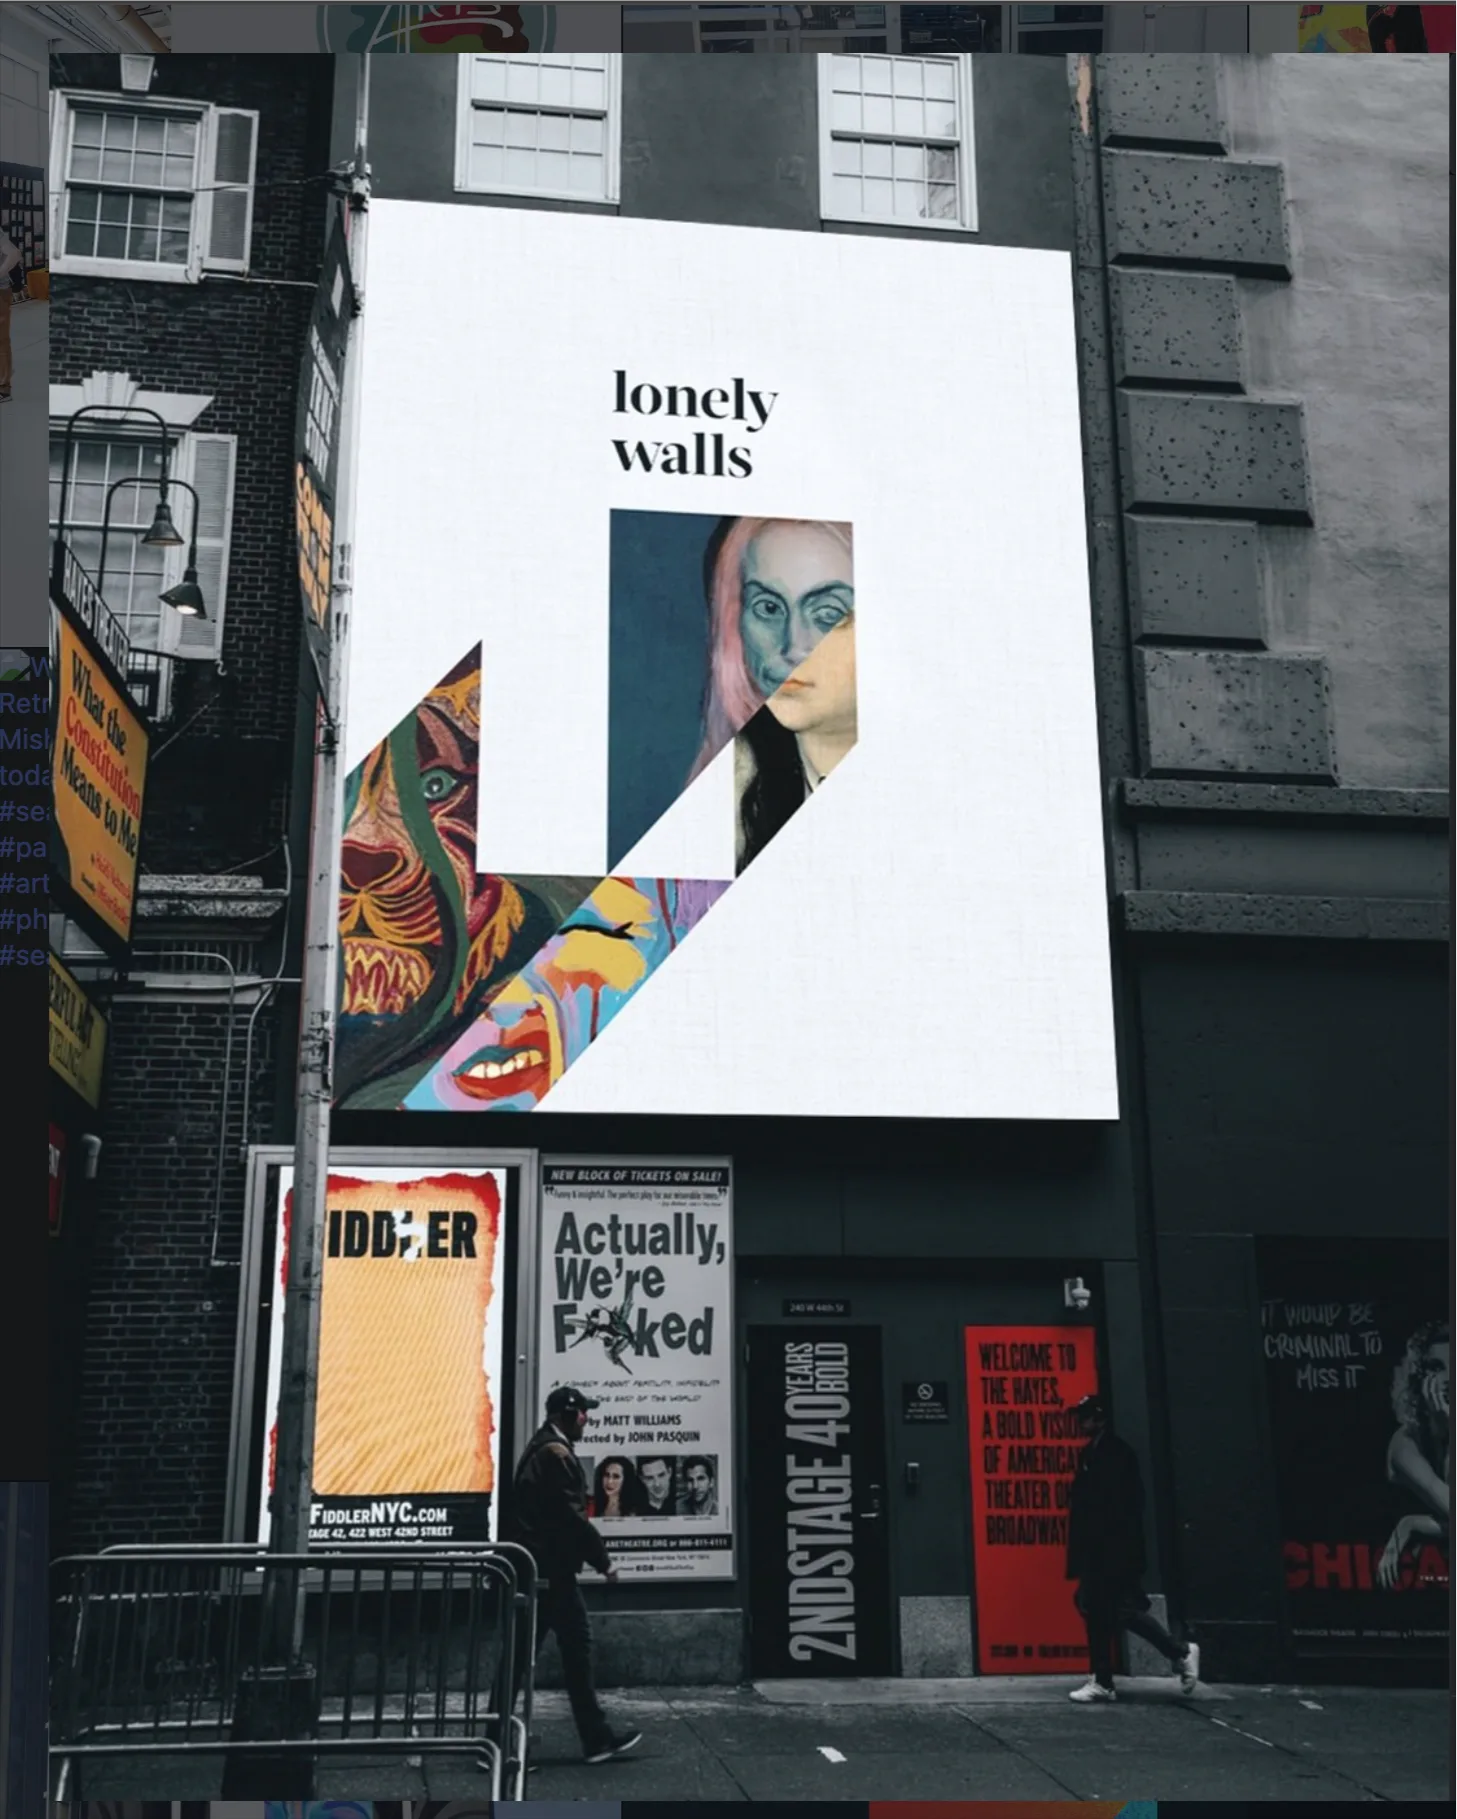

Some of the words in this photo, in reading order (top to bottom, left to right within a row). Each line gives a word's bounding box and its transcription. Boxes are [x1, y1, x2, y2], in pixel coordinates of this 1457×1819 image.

[612, 369, 780, 433] lonely
[610, 431, 753, 479] walls
[71, 648, 106, 731] What
[106, 706, 127, 757] the
[64, 695, 140, 820] Constitution
[60, 737, 102, 820] Means
[103, 798, 118, 837] to
[117, 808, 137, 860] Me
[550, 1169, 576, 1181] NEW
[577, 1169, 611, 1181] BLOCK
[612, 1169, 628, 1181] OF
[630, 1169, 672, 1181] TICKETS
[674, 1170, 690, 1181] ON
[691, 1170, 723, 1182] SALE!
[554, 1211, 726, 1266] Actually,
[1261, 1298, 1285, 1327] IT
[1284, 1303, 1342, 1327] WOULD
[1347, 1302, 1375, 1325] BE
[553, 1302, 714, 1359] Fked
[1264, 1332, 1360, 1359] CRIMINAL
[1359, 1330, 1383, 1356] TO
[785, 1342, 814, 1397] YEARS
[814, 1342, 849, 1393] BOLD
[978, 1342, 1053, 1372] WELCOME
[1056, 1343, 1077, 1373] TO
[979, 1376, 1009, 1405] THE
[1012, 1376, 1065, 1409] HAYES,
[1296, 1362, 1340, 1391] MISS
[1344, 1365, 1367, 1388] IT
[588, 1416, 601, 1429] by
[602, 1415, 631, 1426] MATT
[633, 1414, 682, 1426] WILLIAMS
[784, 1394, 850, 1447] 40
[982, 1410, 994, 1439] A
[996, 1410, 1035, 1440] BOLD
[612, 1432, 626, 1445] by
[628, 1431, 654, 1442] JOHN
[656, 1431, 701, 1444] PASQUIN
[983, 1445, 1003, 1475] OF
[985, 1480, 1050, 1509] THEATER
[331, 1527, 347, 1540] 42,
[348, 1527, 366, 1538] 422
[368, 1527, 393, 1538] WEST
[394, 1526, 419, 1538] 42ND
[420, 1526, 454, 1537] STREET
[986, 1515, 1067, 1545] BROADWAY
[786, 1454, 857, 1661] 2NDSTAGE
